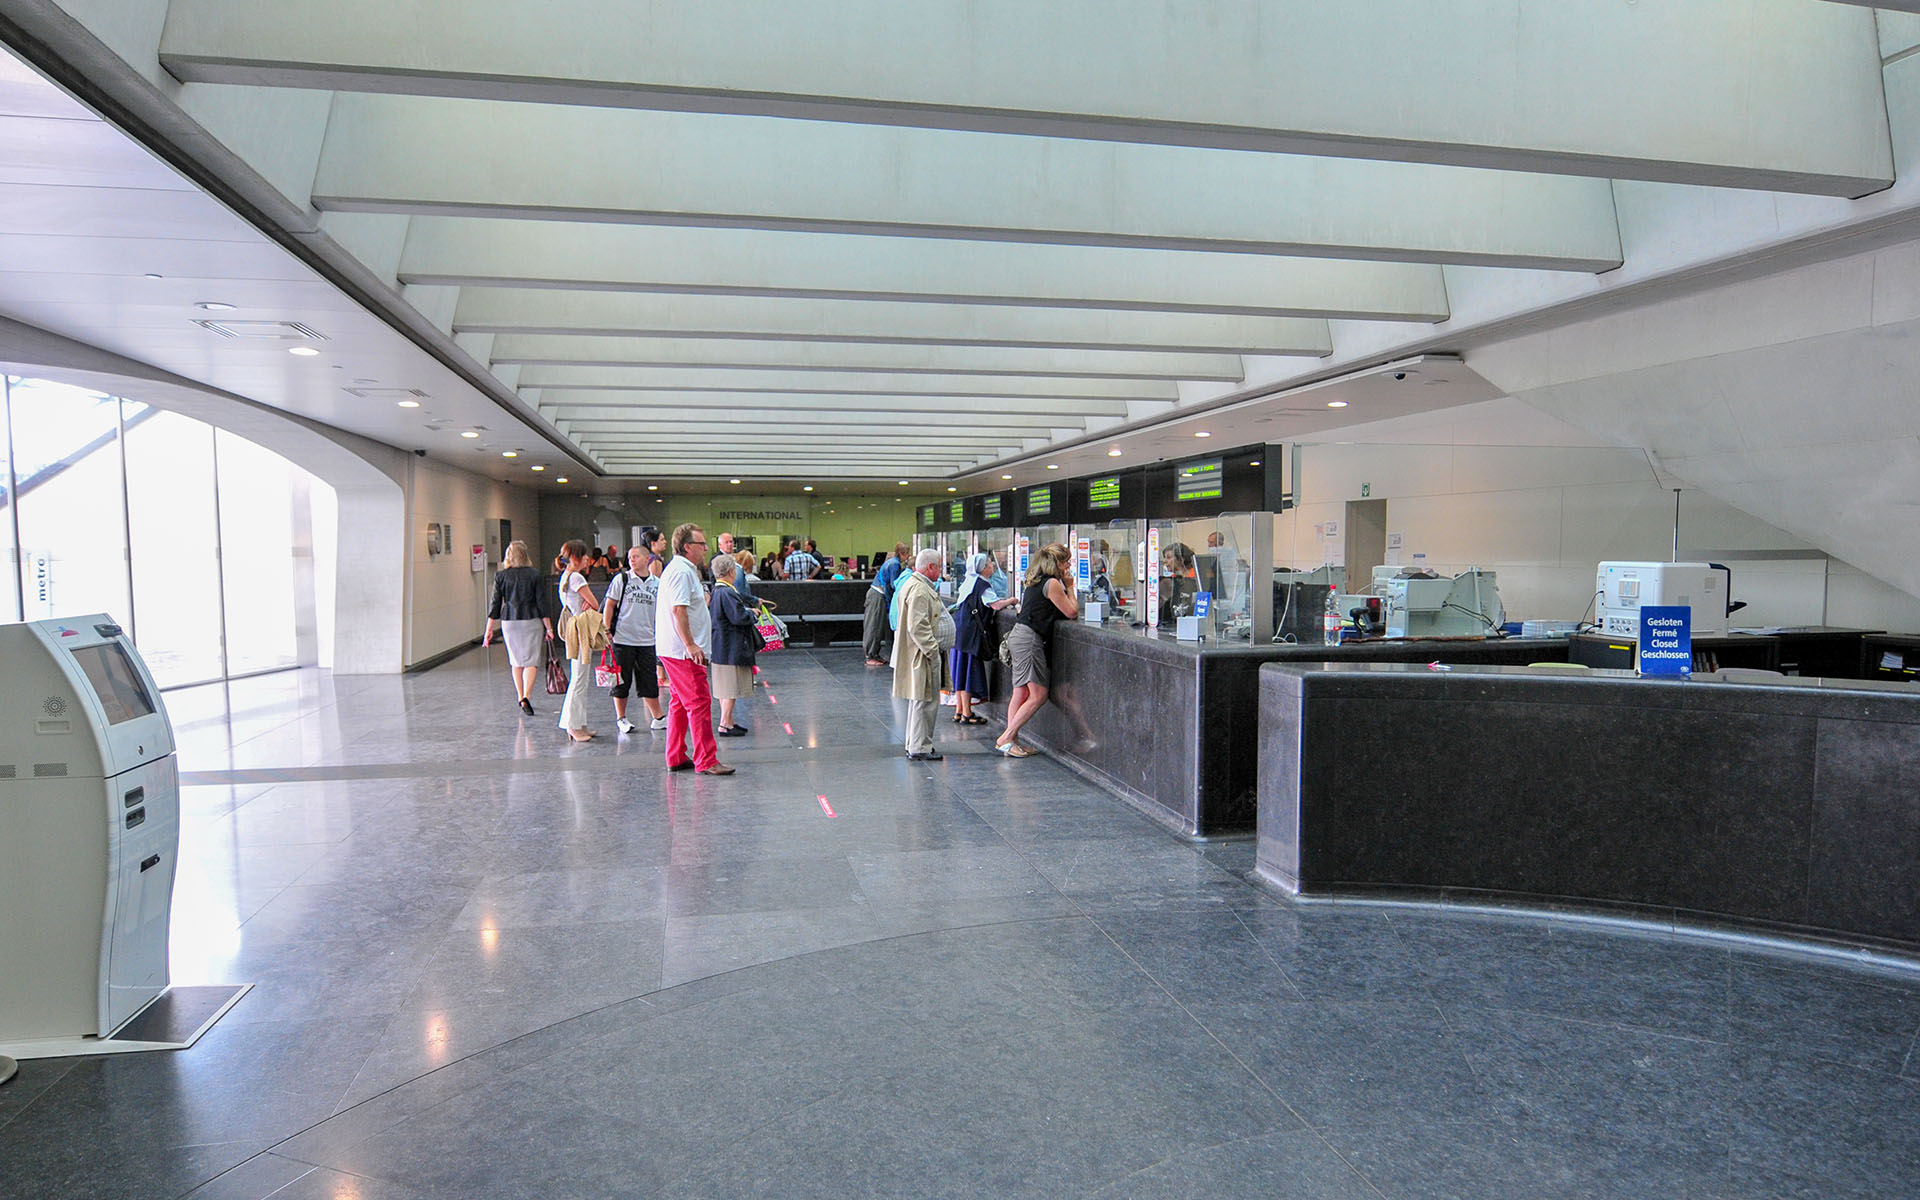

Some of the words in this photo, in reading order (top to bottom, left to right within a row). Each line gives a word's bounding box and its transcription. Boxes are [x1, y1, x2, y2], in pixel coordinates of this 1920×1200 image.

[720, 511, 802, 520] INTERNATIONAL
[37, 558, 46, 601] metro
[1647, 617, 1683, 627] Gesloten
[1652, 629, 1678, 638] Fermé
[1651, 639, 1679, 648] Closed
[1641, 650, 1690, 659] Geschlossen
